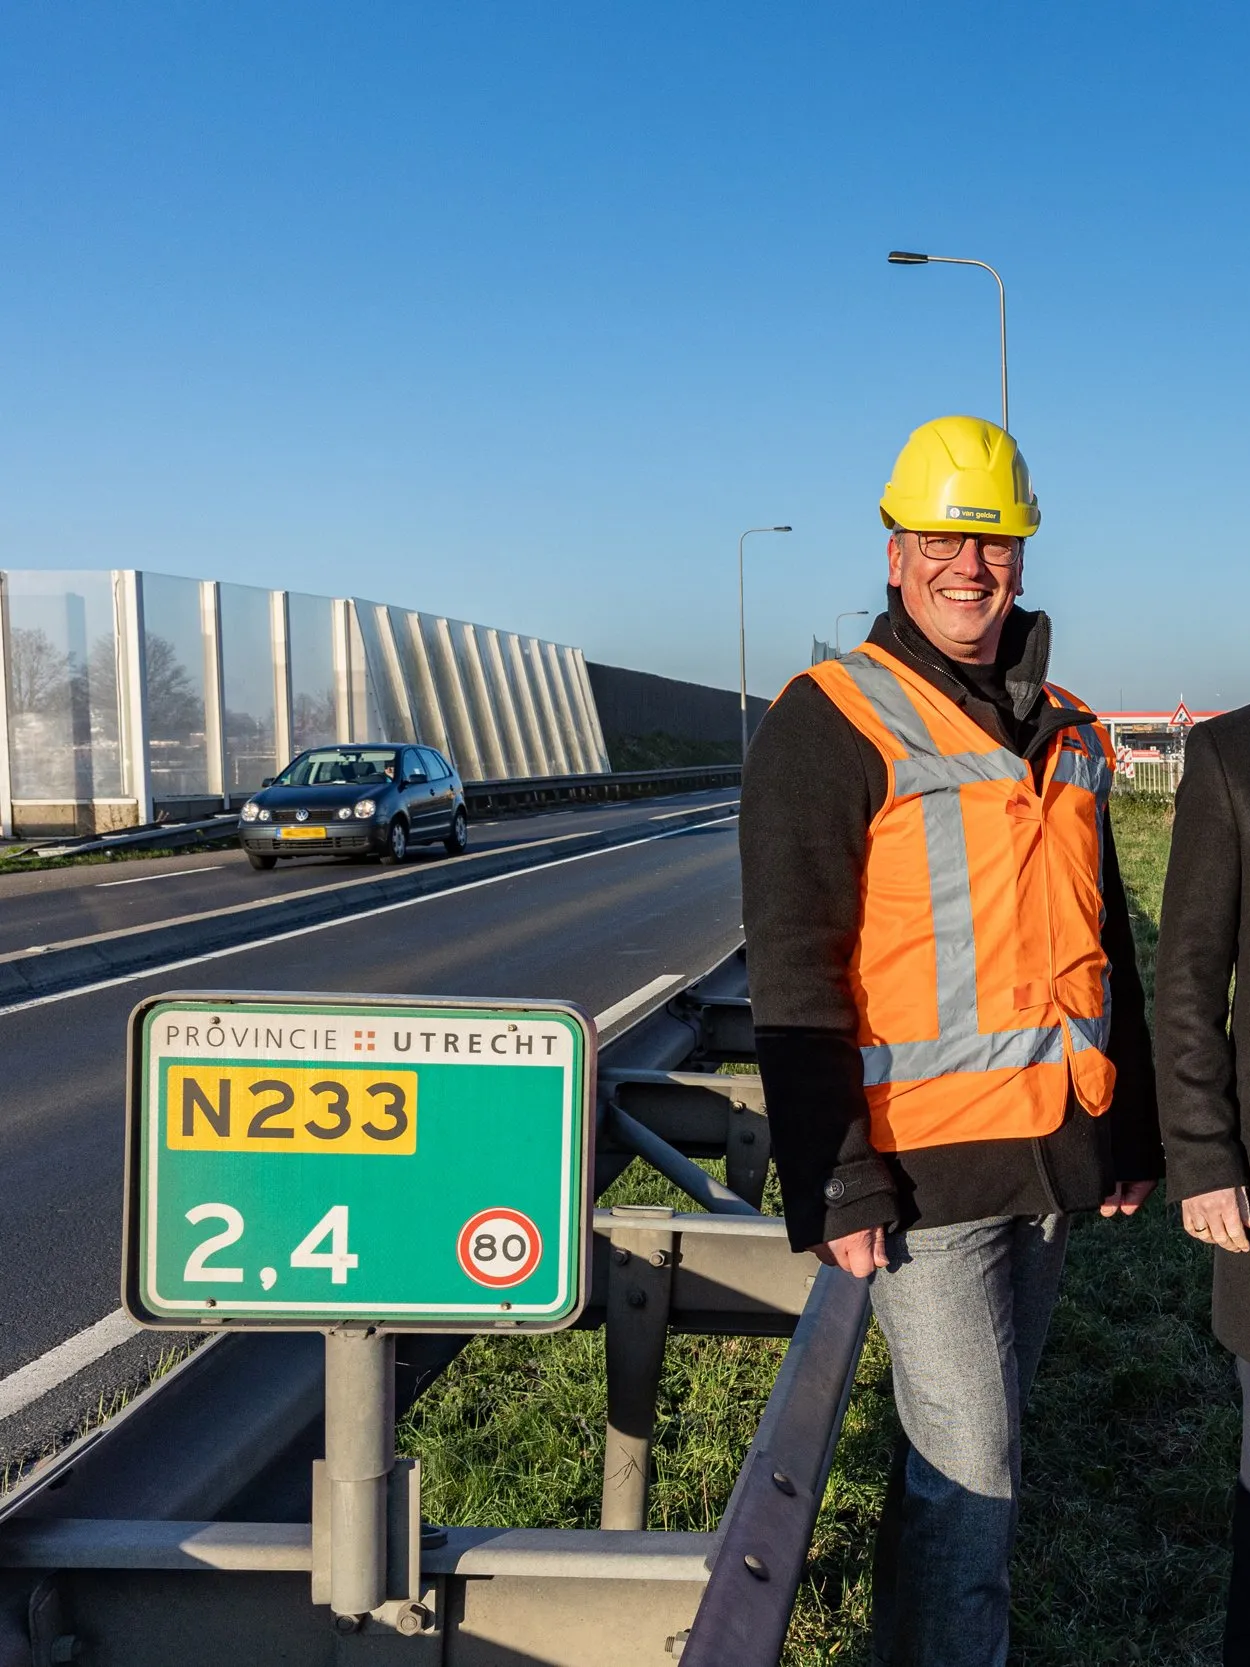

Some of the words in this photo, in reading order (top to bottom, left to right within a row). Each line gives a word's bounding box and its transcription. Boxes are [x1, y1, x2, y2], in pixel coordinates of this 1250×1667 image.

[166, 1024, 338, 1050] PROVINCIE
[392, 1032, 558, 1055] UTRECHT
[182, 1077, 409, 1141] N233
[183, 1202, 359, 1291] 2,4
[473, 1234, 527, 1262] 80
